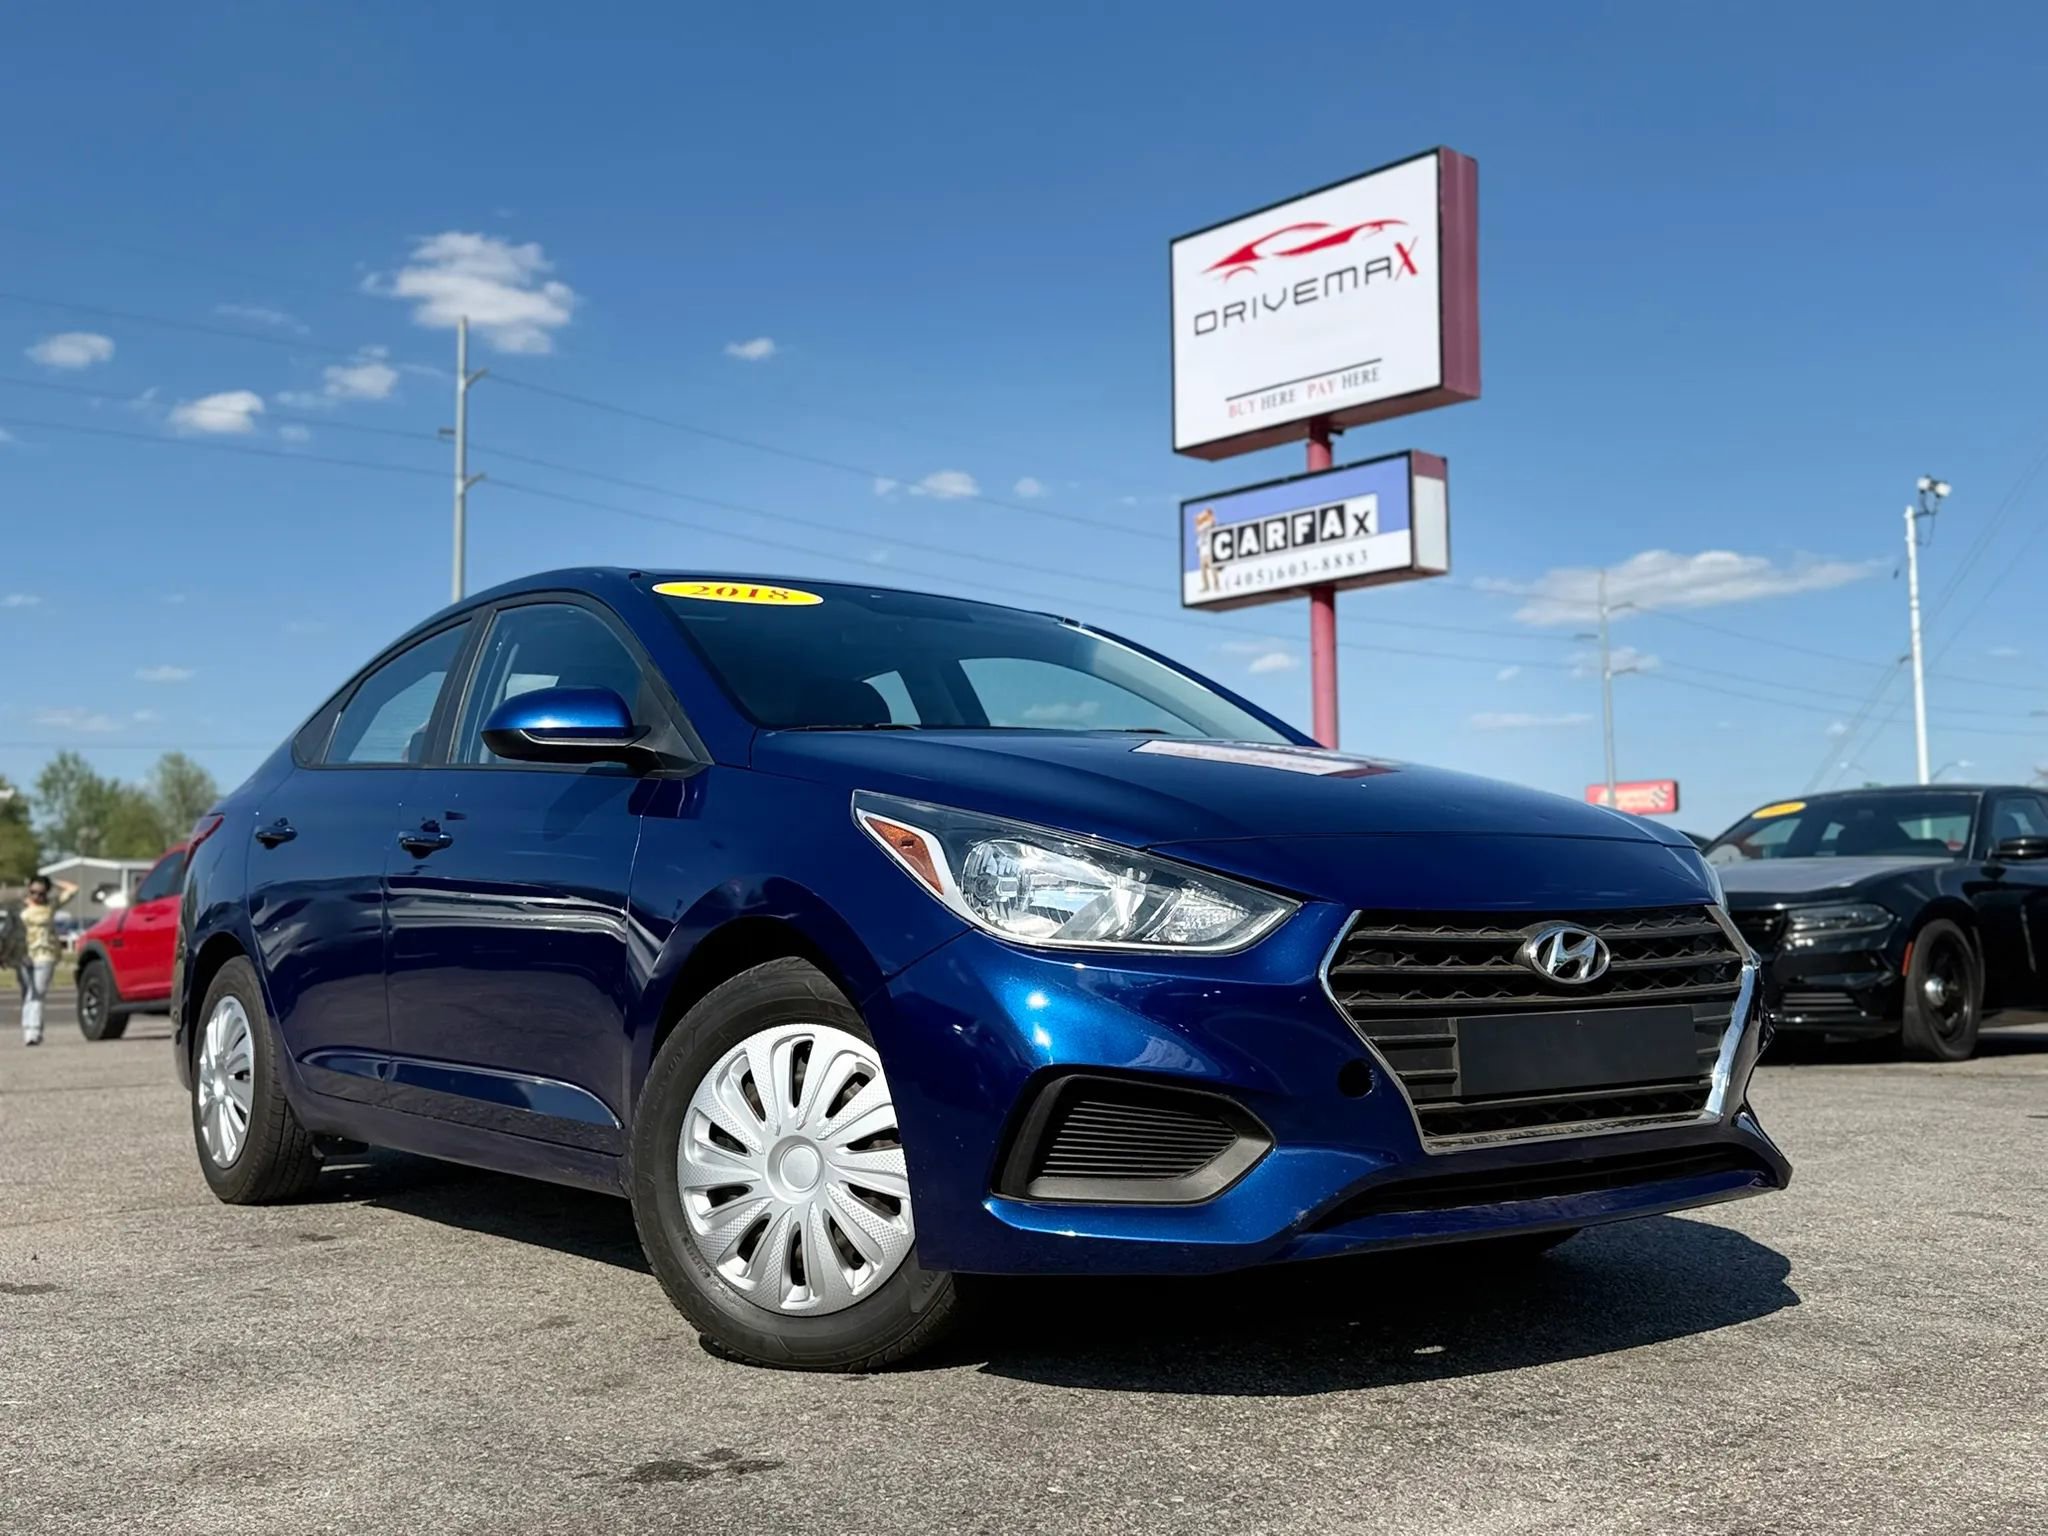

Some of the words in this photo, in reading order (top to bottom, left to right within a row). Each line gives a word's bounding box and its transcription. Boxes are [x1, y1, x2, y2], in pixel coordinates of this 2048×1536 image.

[1194, 236, 1418, 336] DRIVEMAX
[1228, 400, 1255, 418] BUY
[1261, 388, 1296, 411] HERE
[1306, 378, 1337, 400] PAY
[1342, 367, 1380, 390] HERE
[1212, 507, 1371, 562] CARFAX
[689, 585, 789, 600] 2018
